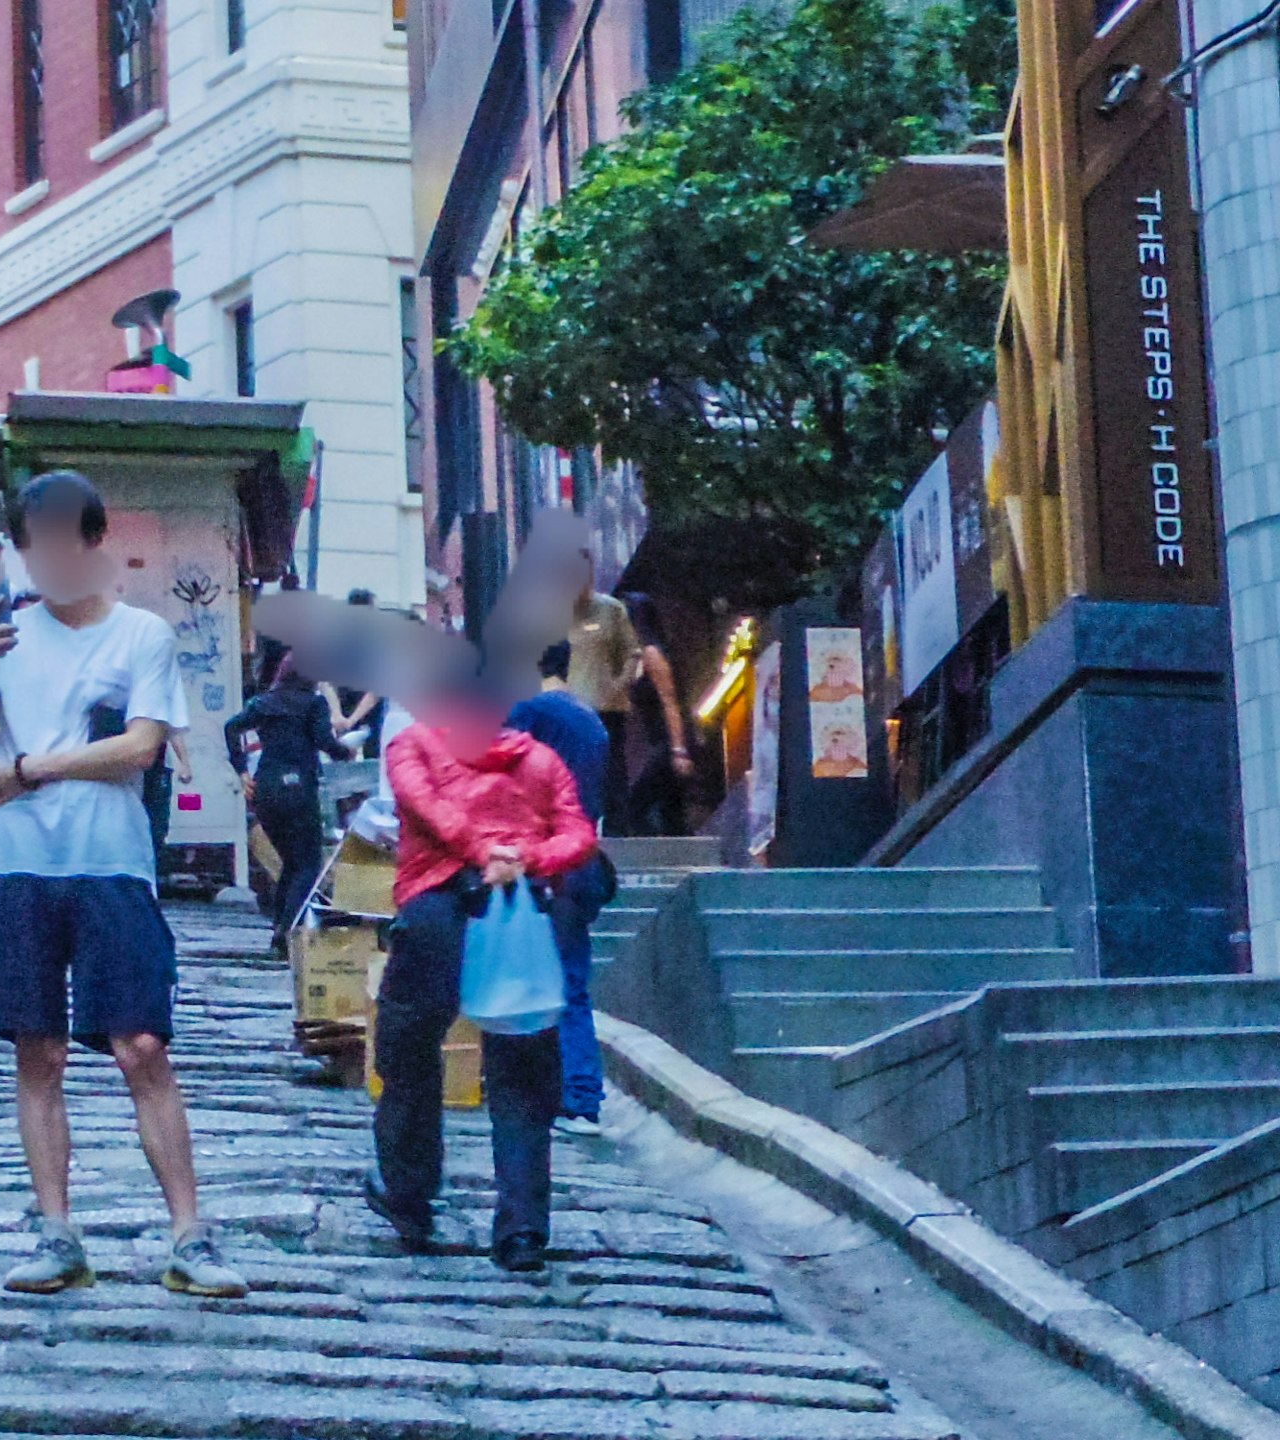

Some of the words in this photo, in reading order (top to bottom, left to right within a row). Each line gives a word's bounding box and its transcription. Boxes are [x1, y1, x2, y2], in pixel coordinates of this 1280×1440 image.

[1136, 189, 1165, 264] THE
[1141, 276, 1173, 400] STEPS
[1150, 425, 1176, 451] H
[1152, 462, 1184, 567] CODE
